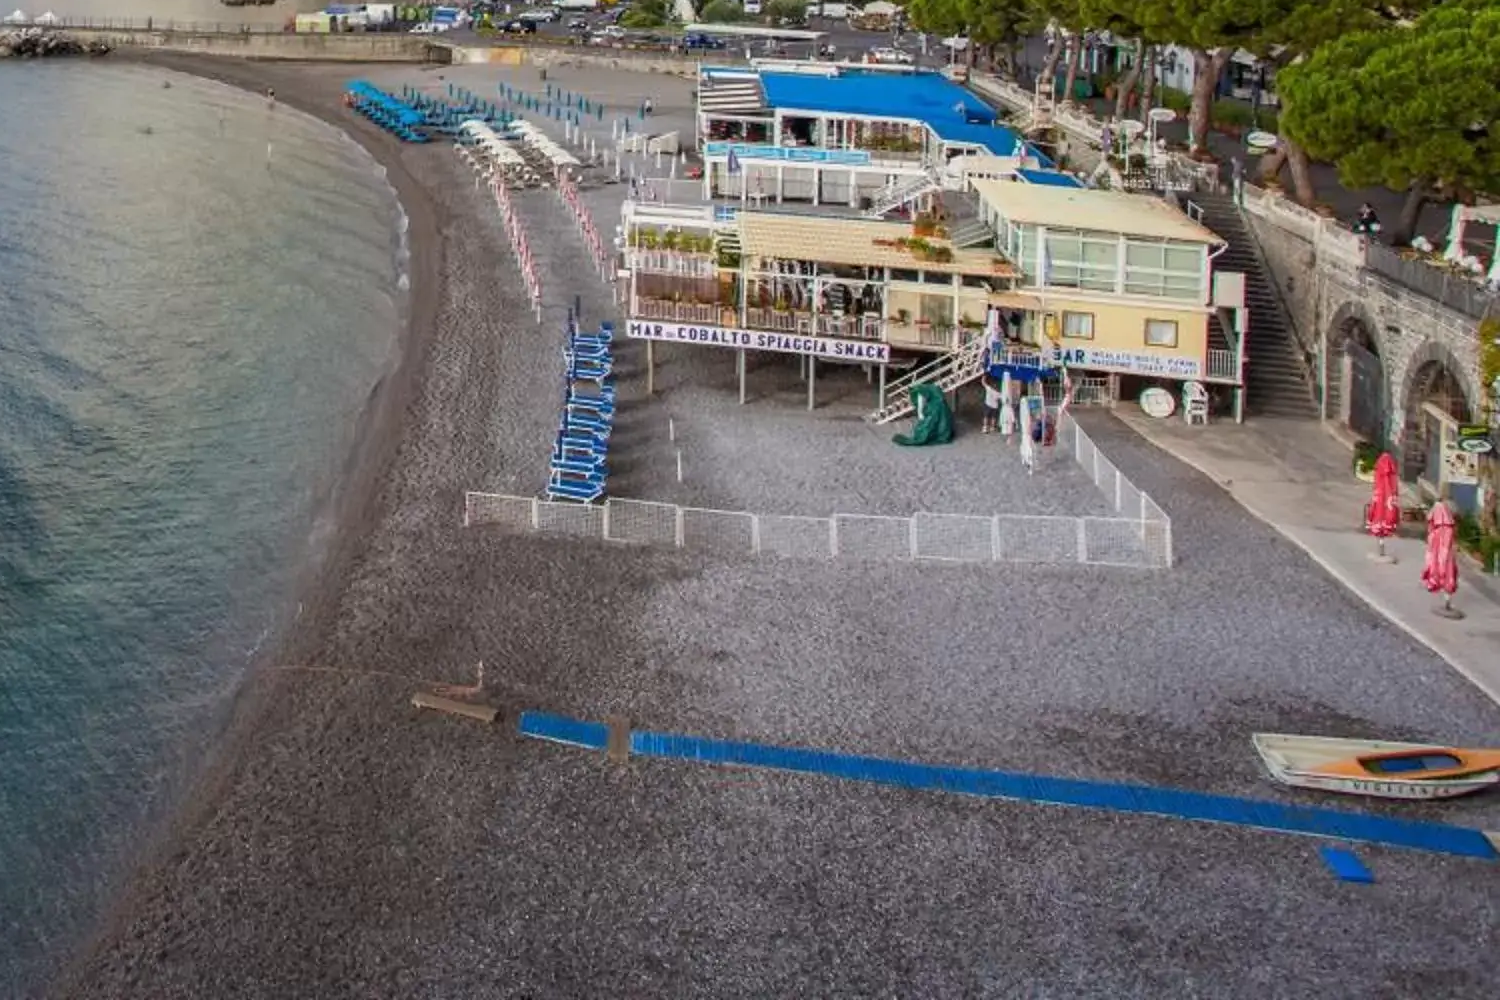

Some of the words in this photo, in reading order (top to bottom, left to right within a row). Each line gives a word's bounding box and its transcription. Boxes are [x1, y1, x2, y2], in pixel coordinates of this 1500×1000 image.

[631, 323, 663, 337] MAR
[678, 327, 751, 345] COBALTO
[835, 342, 885, 359] SNACK
